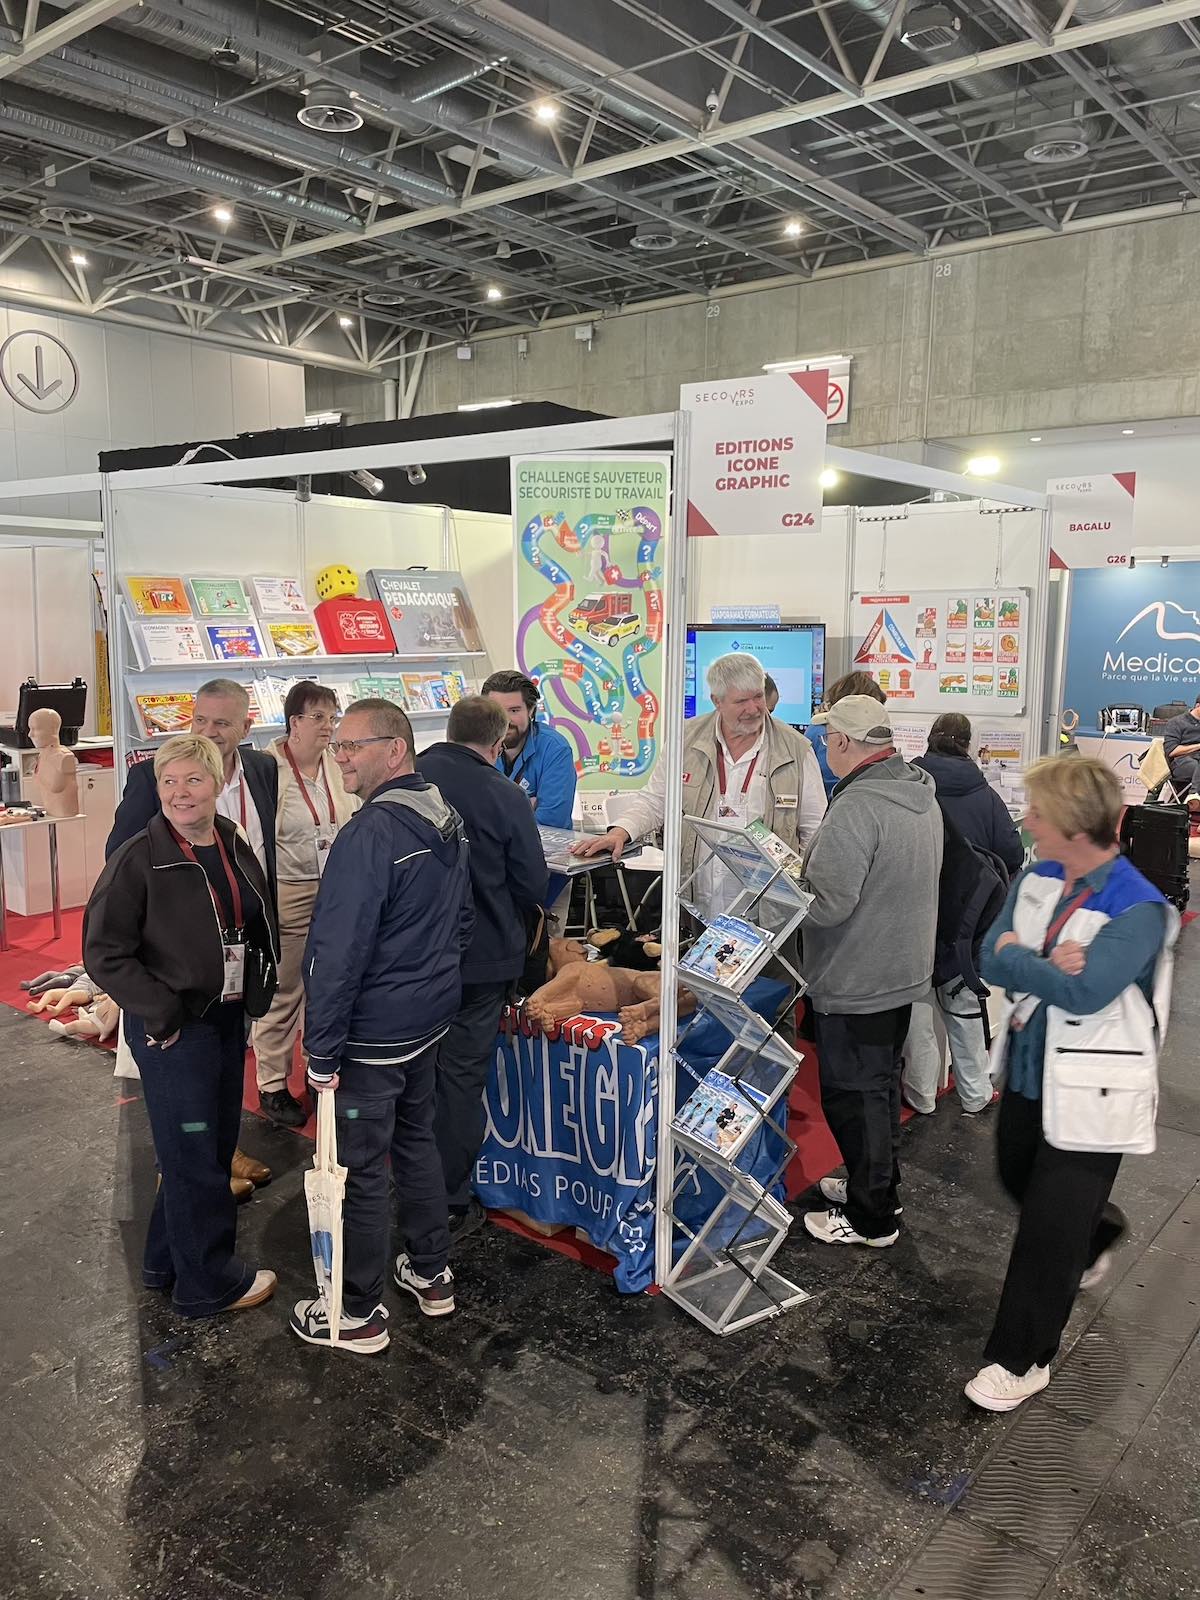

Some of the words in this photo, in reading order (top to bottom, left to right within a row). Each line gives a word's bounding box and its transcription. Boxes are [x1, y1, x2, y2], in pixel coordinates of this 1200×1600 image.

[935, 264, 952, 278] 28
[706, 305, 720, 318] 29
[715, 437, 794, 456] EDITIONS
[727, 456, 779, 472] ICONE
[520, 471, 590, 484] CHALLENGE
[593, 471, 663, 484] SAUVETEUR
[715, 474, 790, 491] GRAPHIC
[519, 486, 591, 499] SECOURISTE
[594, 487, 612, 499] DU
[615, 487, 663, 500] TRAVAIL
[635, 512, 657, 533] Départ
[781, 513, 815, 527] G24
[1069, 522, 1111, 532] BAGALU
[1106, 555, 1126, 564] G26
[380, 578, 420, 590] CHEVALET
[1102, 652, 1200, 674] Medica
[1102, 672, 1127, 680] Parce
[1130, 674, 1148, 683] que
[1152, 674, 1160, 682] la
[470, 1156, 541, 1197] ÉDIAS
[555, 1176, 614, 1220] POUR
